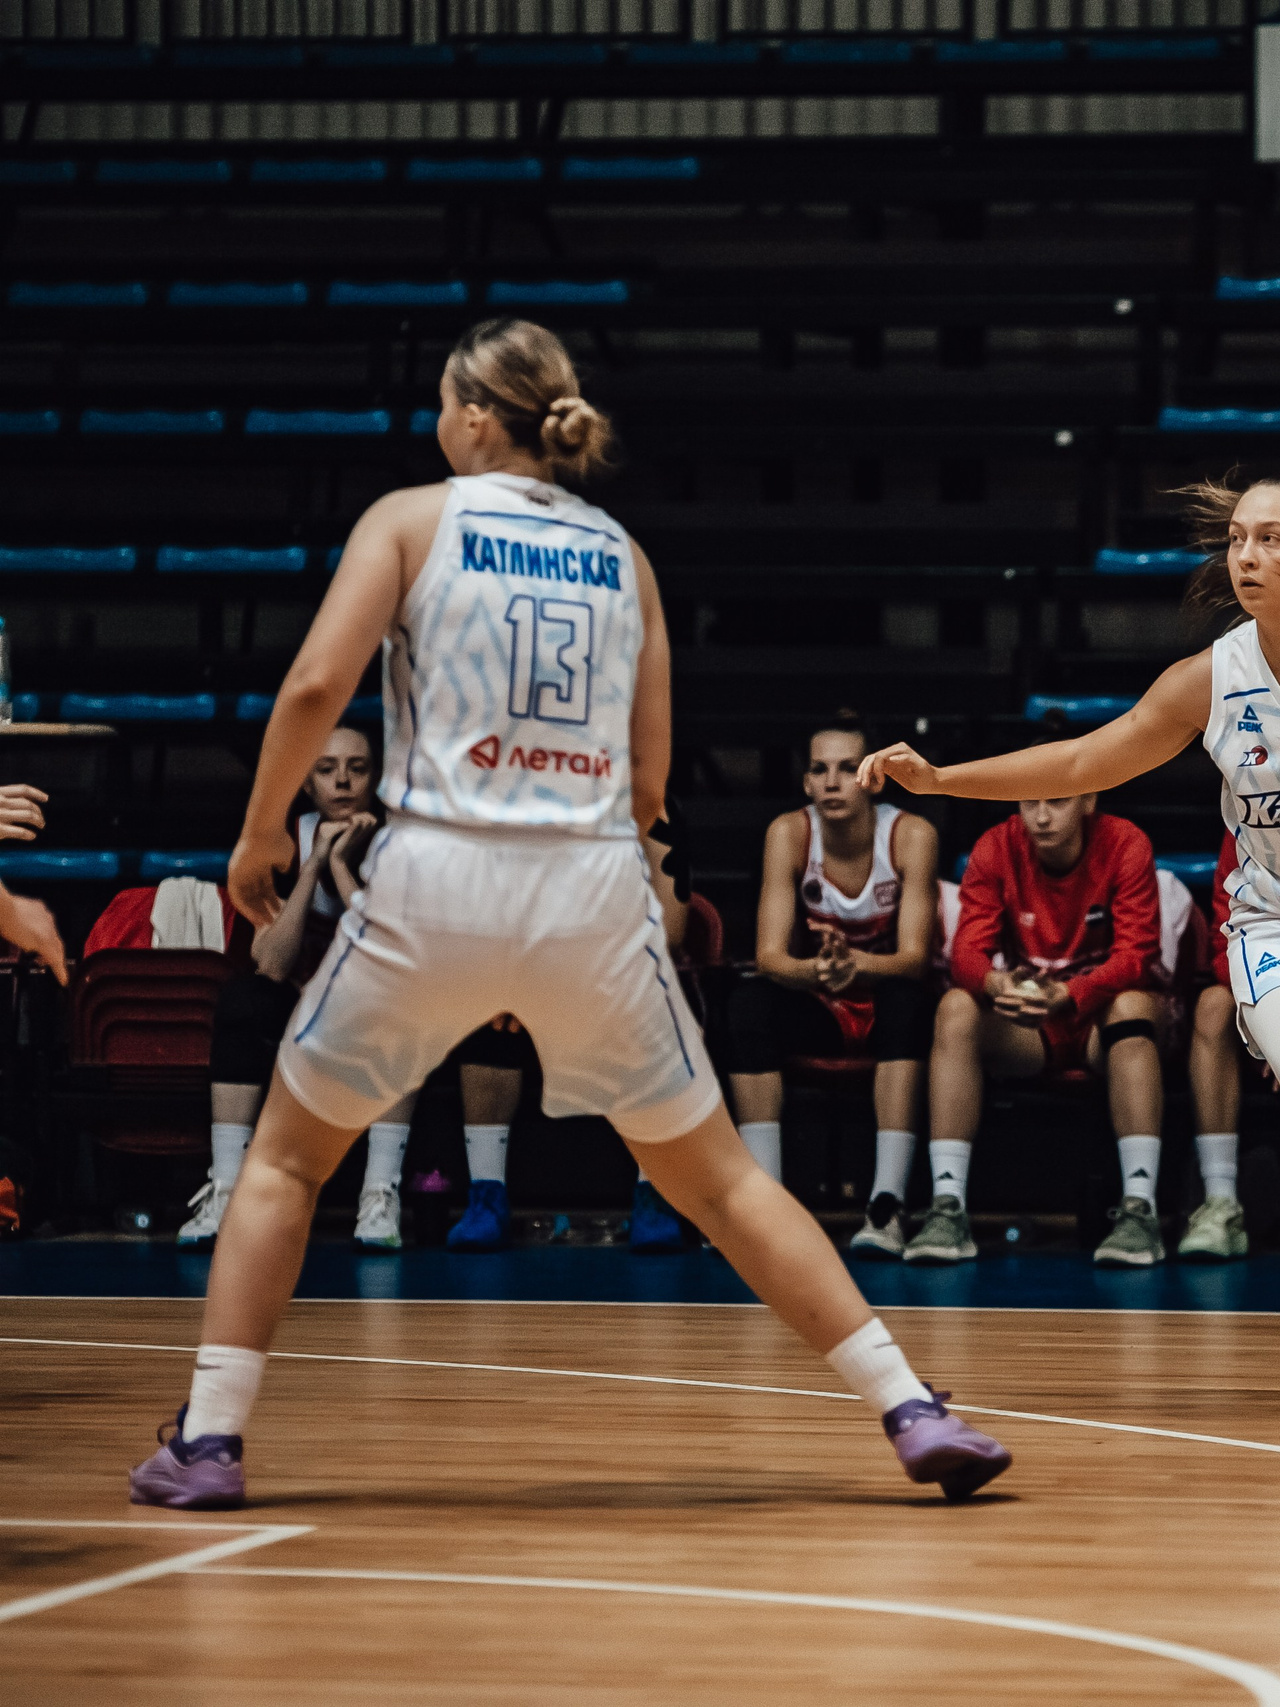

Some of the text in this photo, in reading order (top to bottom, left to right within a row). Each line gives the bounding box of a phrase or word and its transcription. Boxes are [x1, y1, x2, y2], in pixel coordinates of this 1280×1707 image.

[461, 531, 623, 592] КАТЛИНСКАЯ
[504, 593, 594, 726] 13
[1237, 720, 1264, 734] PEAK
[507, 745, 611, 778] летай
